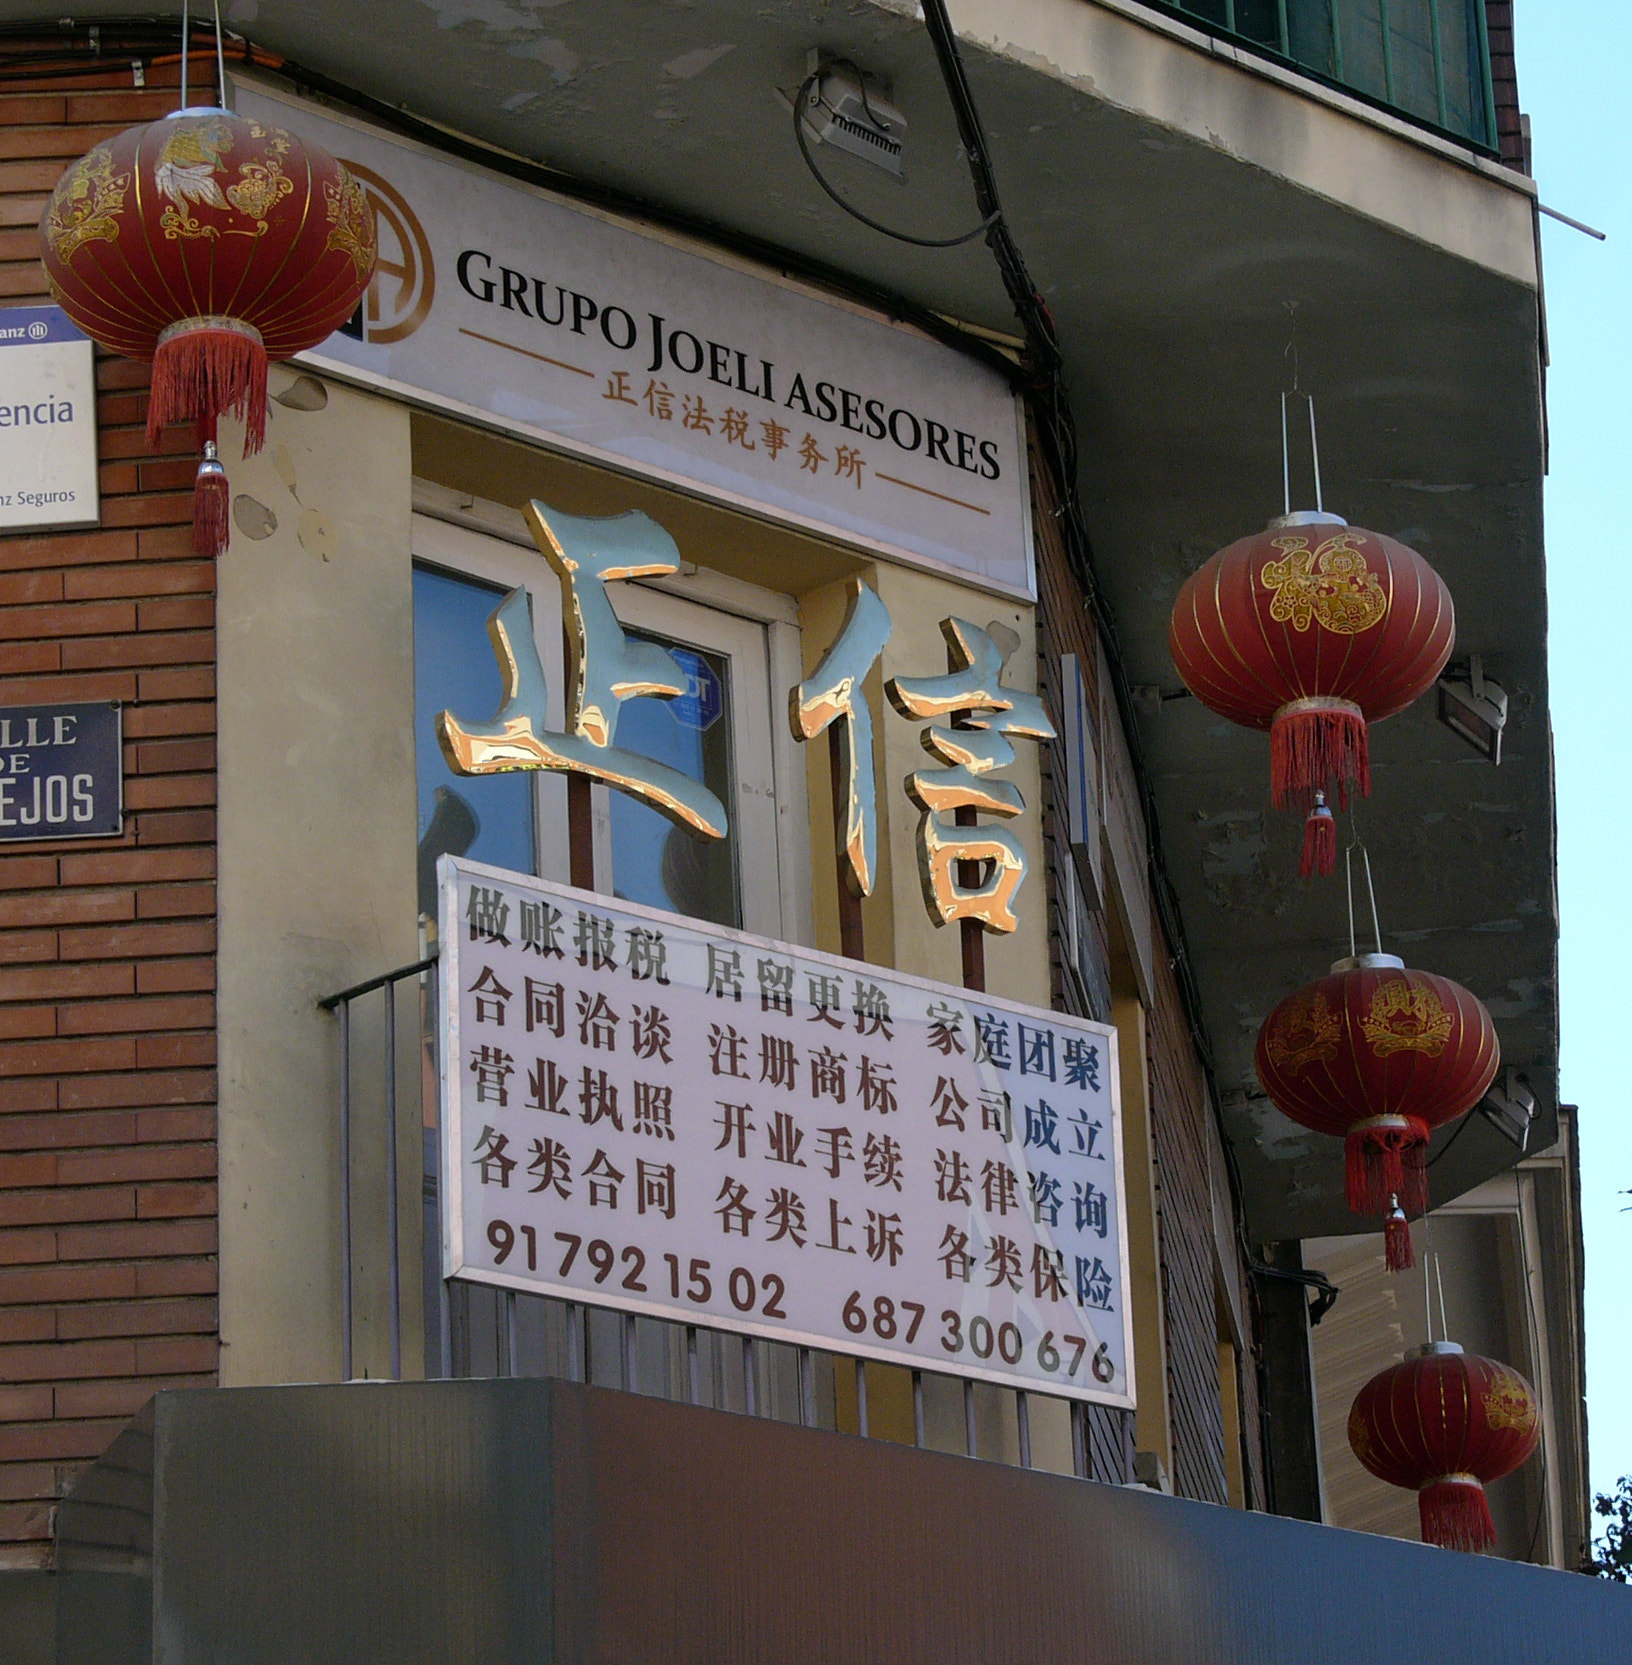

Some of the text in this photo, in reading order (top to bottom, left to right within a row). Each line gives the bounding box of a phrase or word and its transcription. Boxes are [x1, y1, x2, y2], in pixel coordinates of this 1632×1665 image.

[456, 250, 1001, 481] GRUPO JOELI ASESORES
[601, 370, 867, 490] 正信法税事务所
[17, 490, 76, 507] Seguros
[0, 715, 78, 749] LLE
[435, 498, 1057, 935] 正信
[465, 884, 1102, 1093] 做账报税 居留更换 家庭团聚
[467, 965, 1106, 1161] 合同洽谈 注册商标 公司成立
[469, 1044, 1108, 1239] 营业执照 开业手续 法律咨询
[471, 1124, 1115, 1313] 各类合同 各类上诉 各类保险
